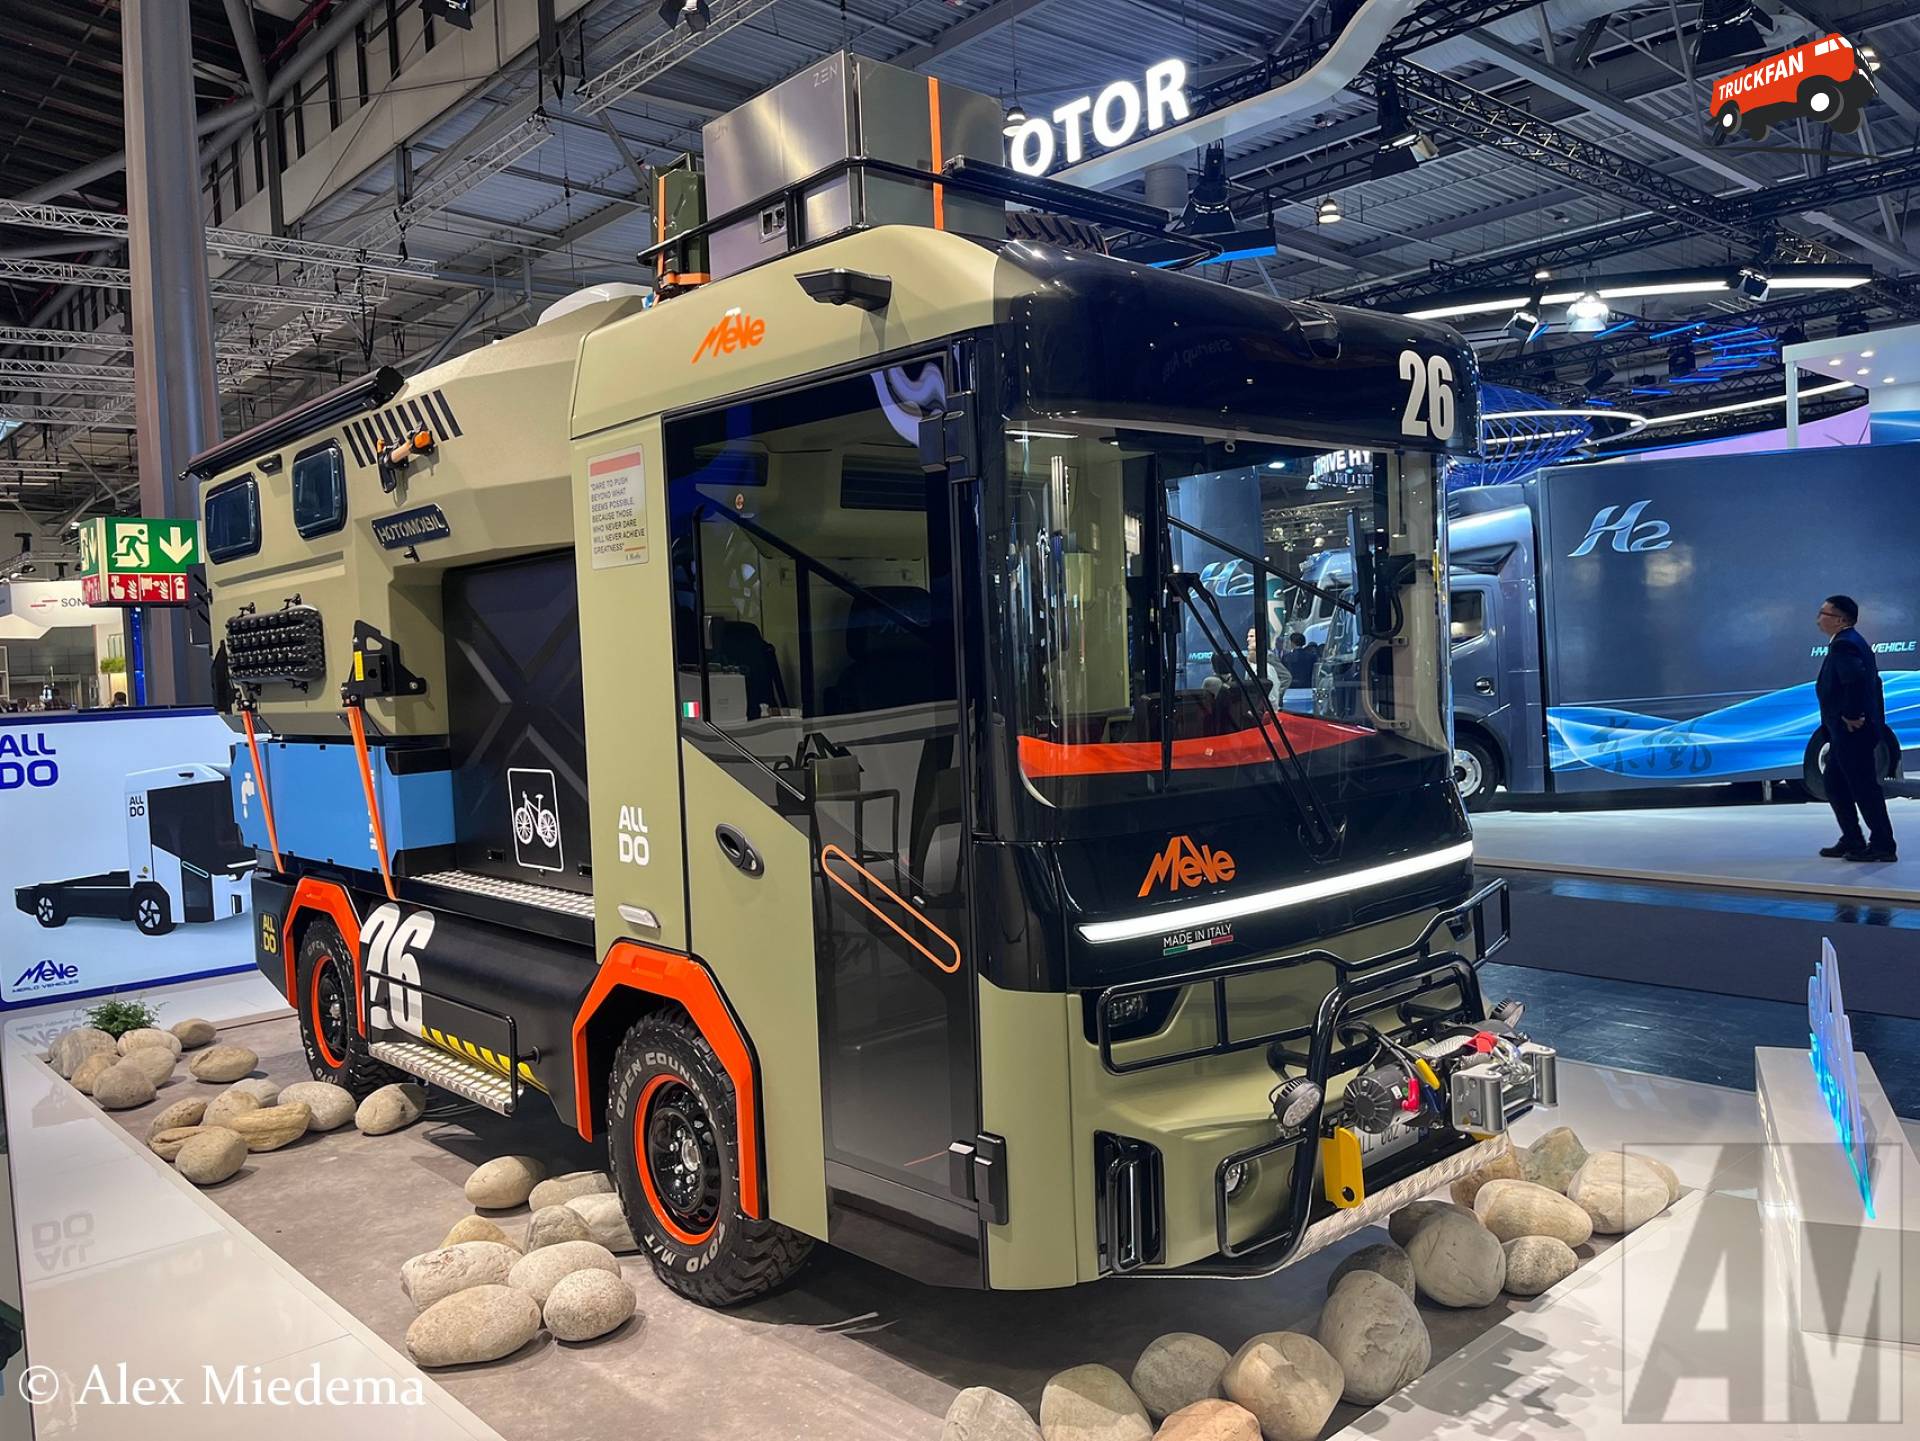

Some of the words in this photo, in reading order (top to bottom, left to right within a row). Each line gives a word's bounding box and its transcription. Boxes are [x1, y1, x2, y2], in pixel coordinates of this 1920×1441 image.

[813, 63, 838, 88] ZEN
[1010, 58, 1190, 177] OTOR
[690, 307, 766, 364] MeVe
[1399, 349, 1455, 441] 26
[607, 479, 613, 488] TO
[592, 502, 608, 512] SEEMS
[592, 511, 615, 523] BECAUSE
[616, 508, 632, 518] THOSE
[377, 514, 446, 543] HOTOMOBIL
[593, 523, 604, 533] WHO
[605, 521, 622, 531] NEVER
[622, 518, 637, 528] DARE
[593, 535, 605, 545] WILL
[605, 532, 622, 542] NEVER
[622, 528, 646, 539] ACHIEVE
[1568, 500, 1673, 557] H2
[1871, 641, 1918, 653] VEHICLE
[0, 733, 56, 758] ALL
[0, 760, 58, 789] DO
[129, 795, 144, 806] ALL
[129, 806, 145, 817] DO
[619, 805, 648, 833] ALL
[619, 832, 650, 866] DO
[1137, 835, 1236, 898] MeVe
[263, 914, 275, 932] ALL
[1163, 931, 1193, 948] MADE
[1194, 927, 1205, 941] IN
[1206, 923, 1233, 939] ITALY
[263, 931, 277, 953] DO
[13, 959, 79, 987] MeVe
[359, 902, 435, 1038] 26
[41, 980, 79, 989] VEHICLES
[616, 1058, 643, 1119] OPEN
[644, 1233, 677, 1266] M/T
[685, 1221, 726, 1273] TOYO
